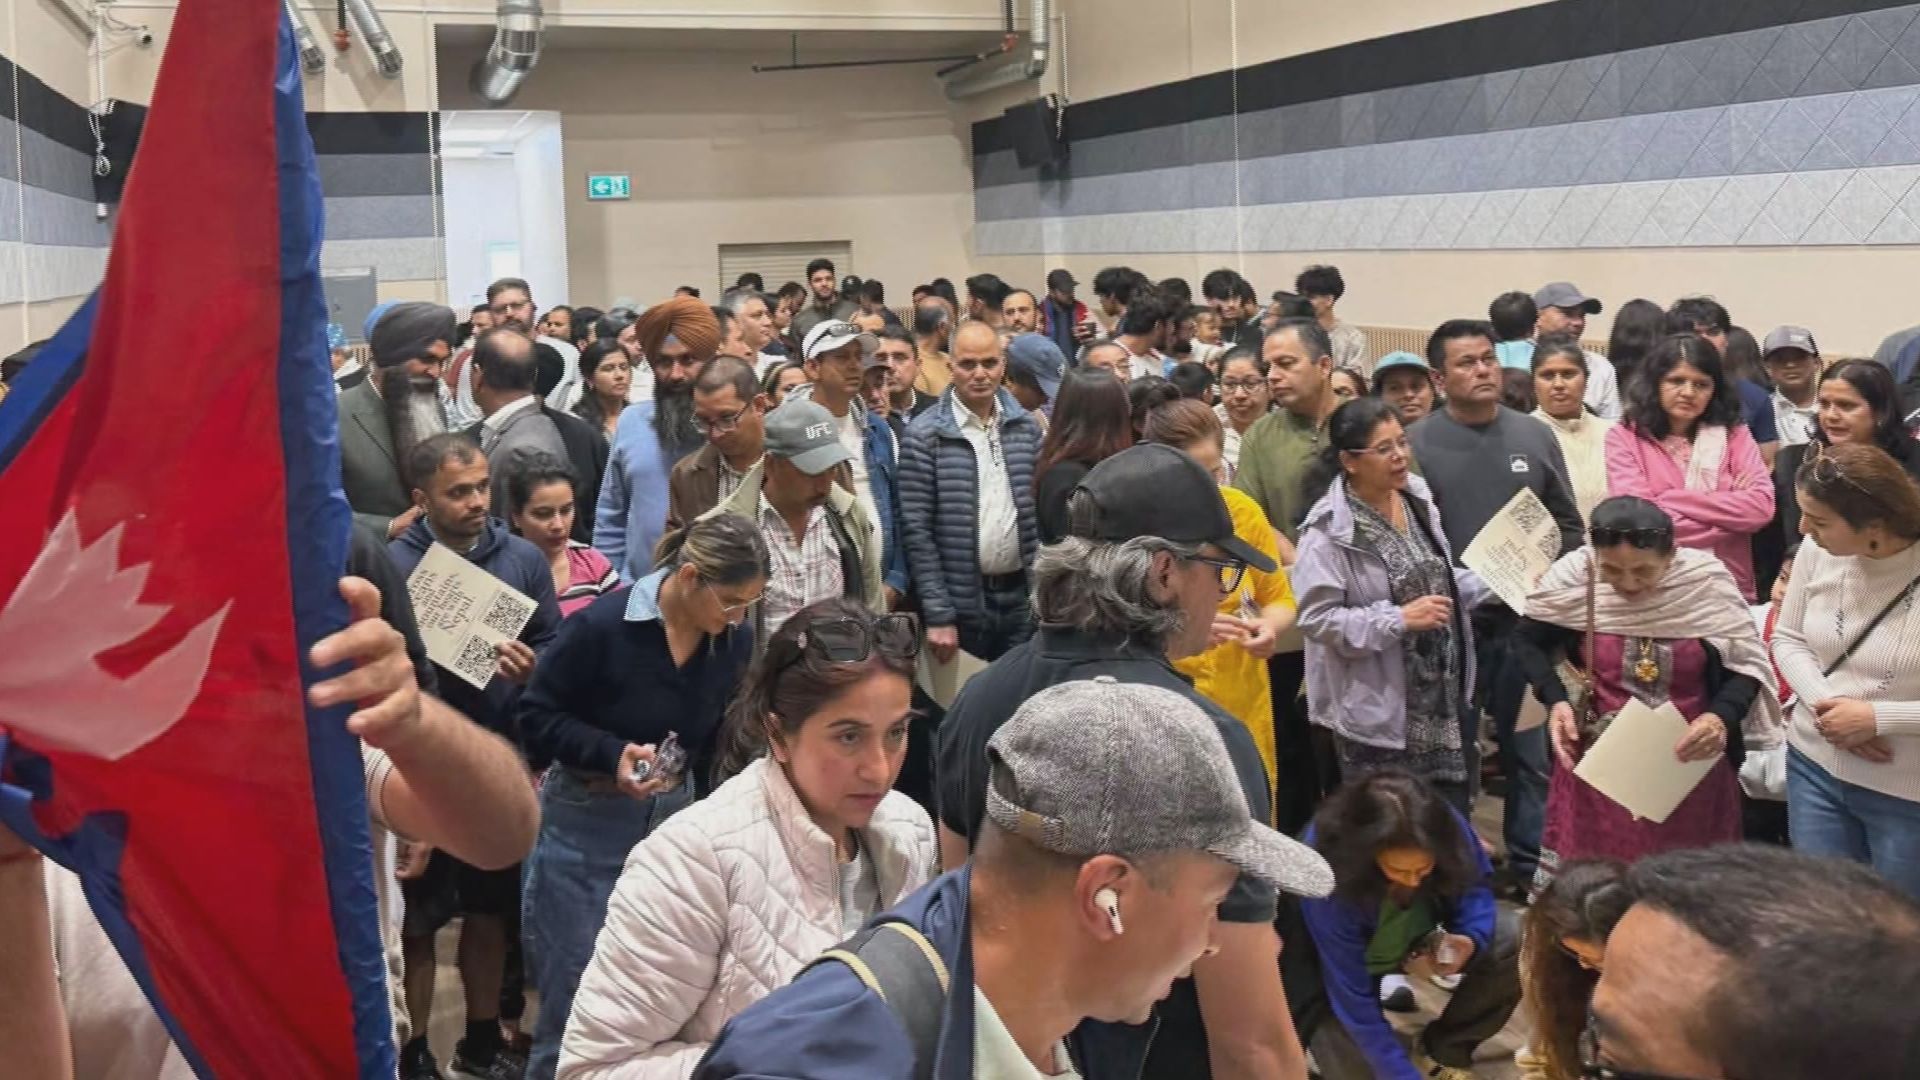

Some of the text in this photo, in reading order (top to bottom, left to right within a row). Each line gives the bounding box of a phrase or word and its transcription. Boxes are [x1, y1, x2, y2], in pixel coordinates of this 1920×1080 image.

[805, 422, 832, 440] UFC
[436, 580, 462, 611] hearts
[440, 595, 476, 635] Nepal.
